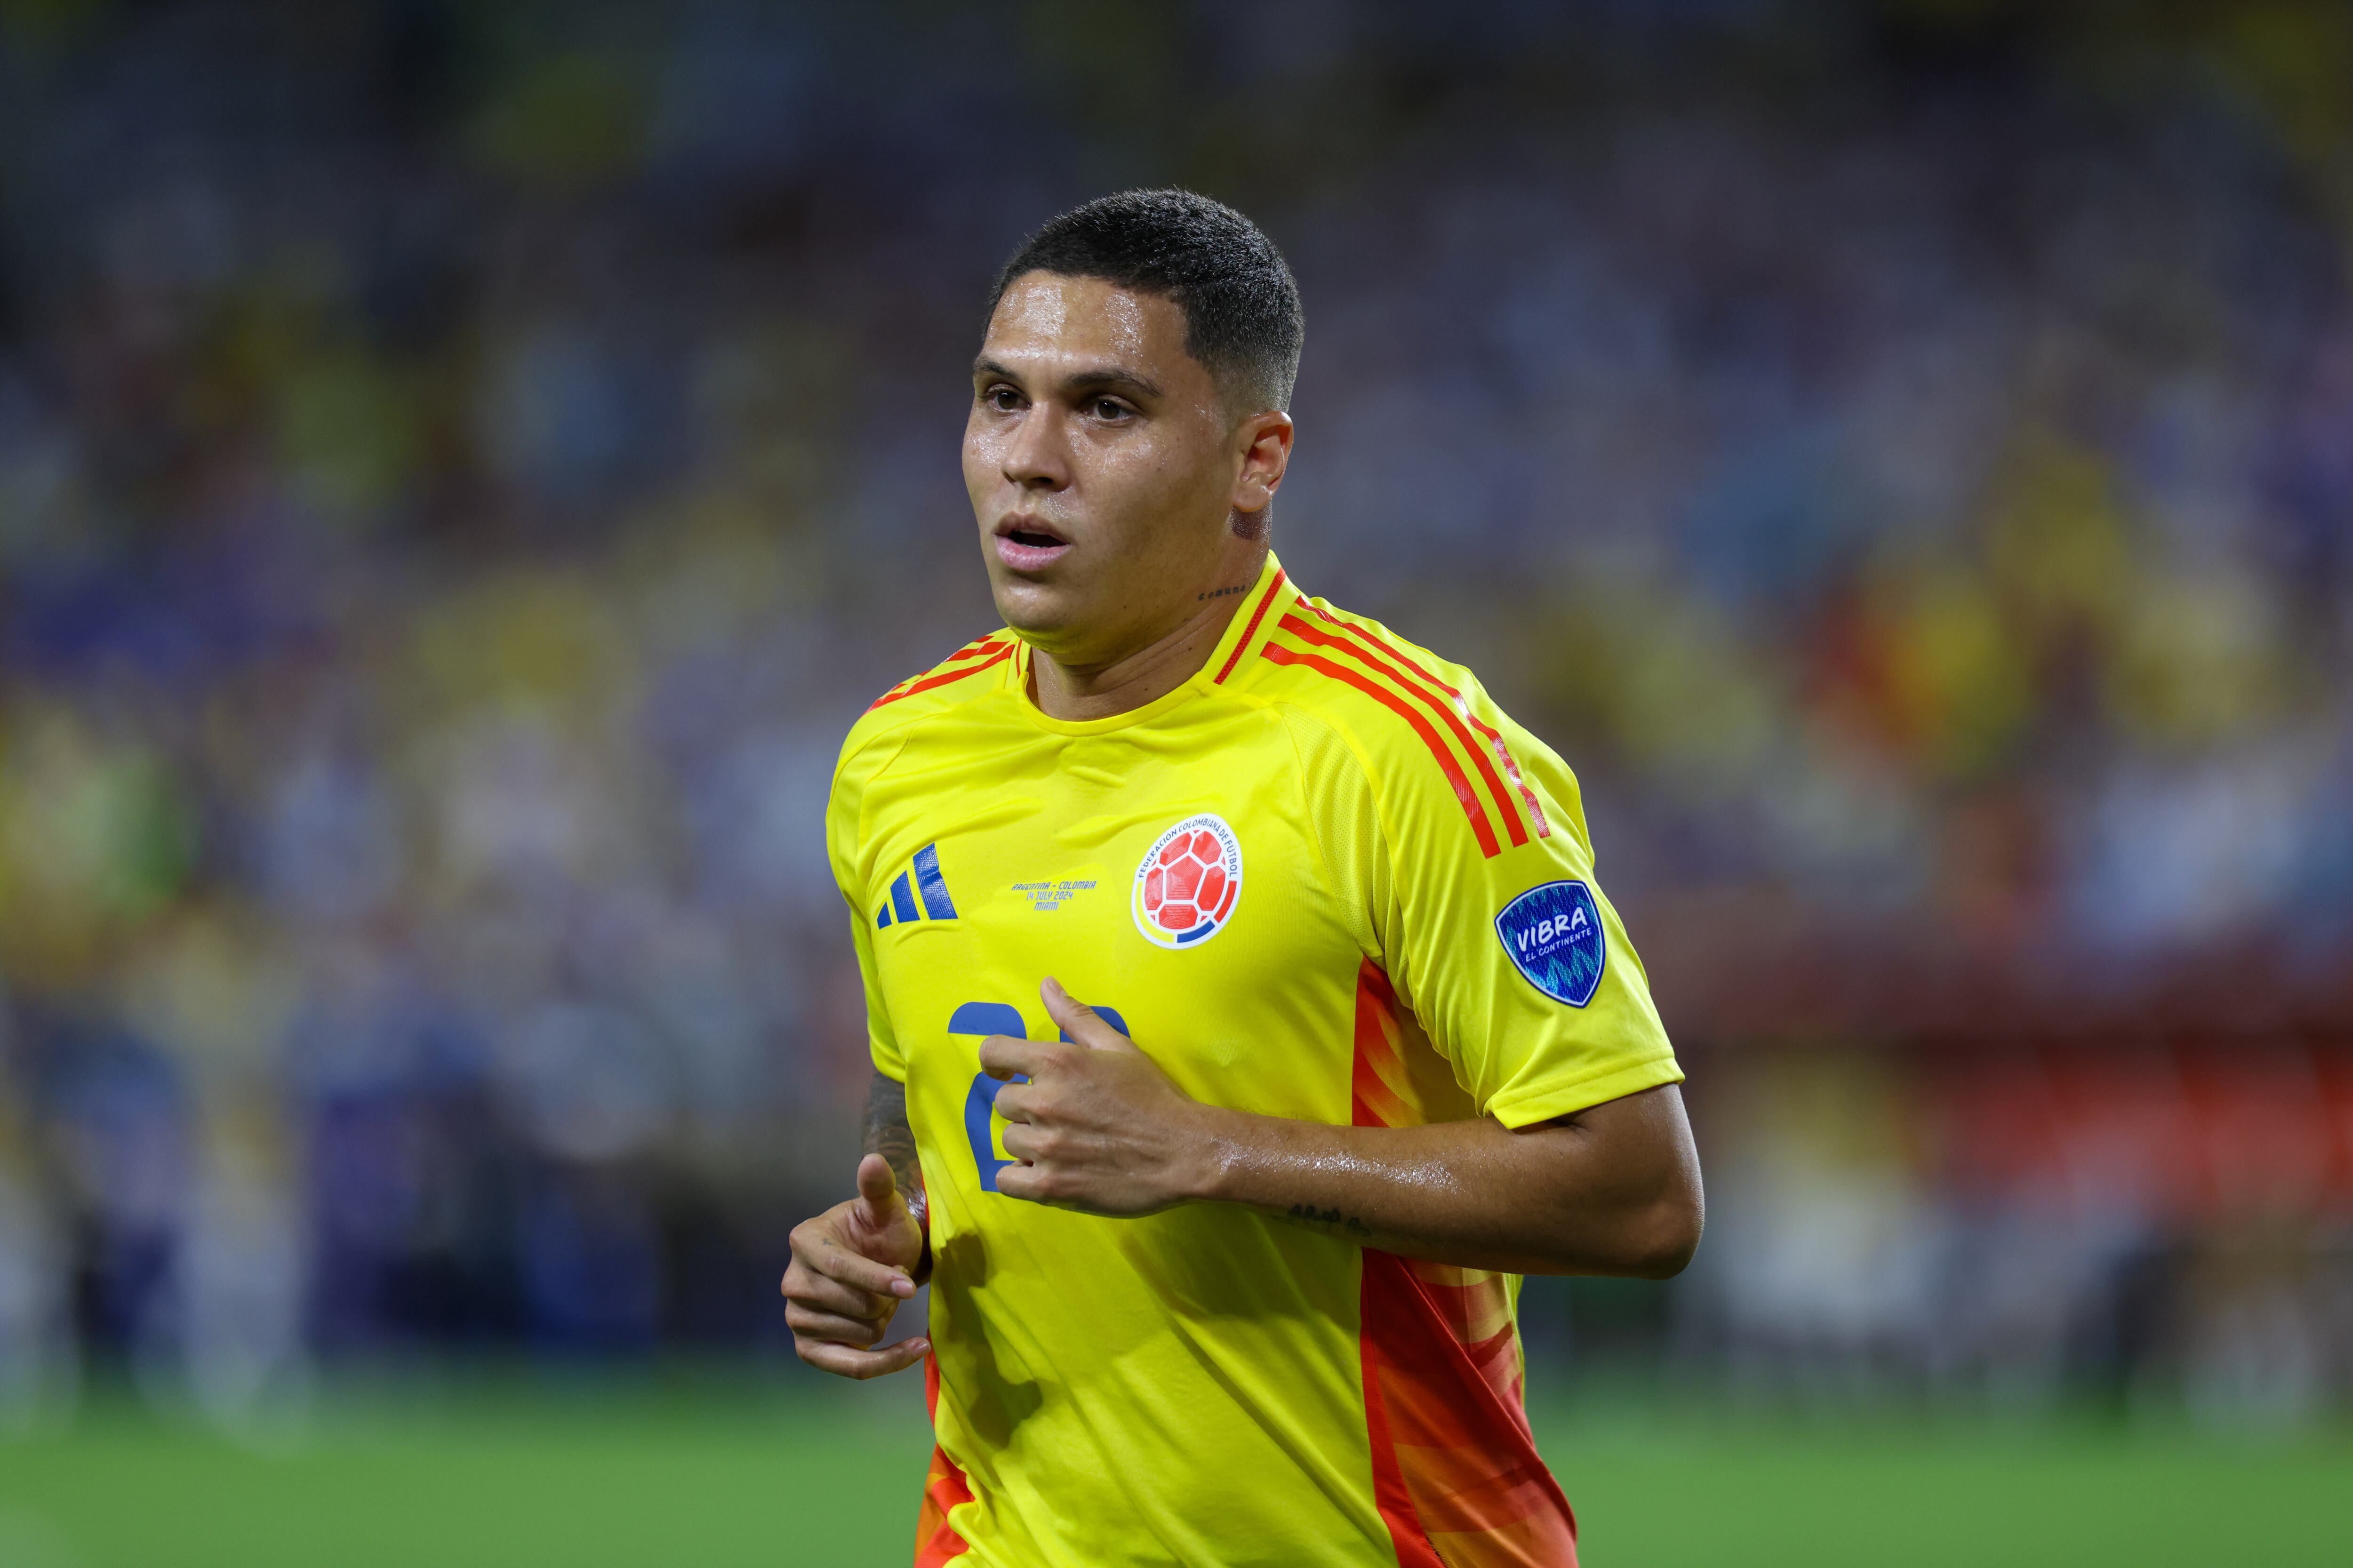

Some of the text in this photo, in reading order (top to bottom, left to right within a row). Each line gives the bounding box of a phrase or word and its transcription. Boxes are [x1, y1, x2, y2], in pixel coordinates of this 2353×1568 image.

[1178, 818, 1221, 832] COLOMBIANA
[1218, 829, 1229, 841] DE
[1011, 882, 1051, 890] ARGENTINA
[1059, 880, 1097, 889] COLOMBIA
[1026, 891, 1073, 901] 14 JULY 2024
[1034, 902, 1059, 911] MIAMI
[1517, 906, 1588, 951] VIBRA
[1525, 927, 1592, 962] EL CONTINENTE
[947, 1001, 1131, 1193] 2
